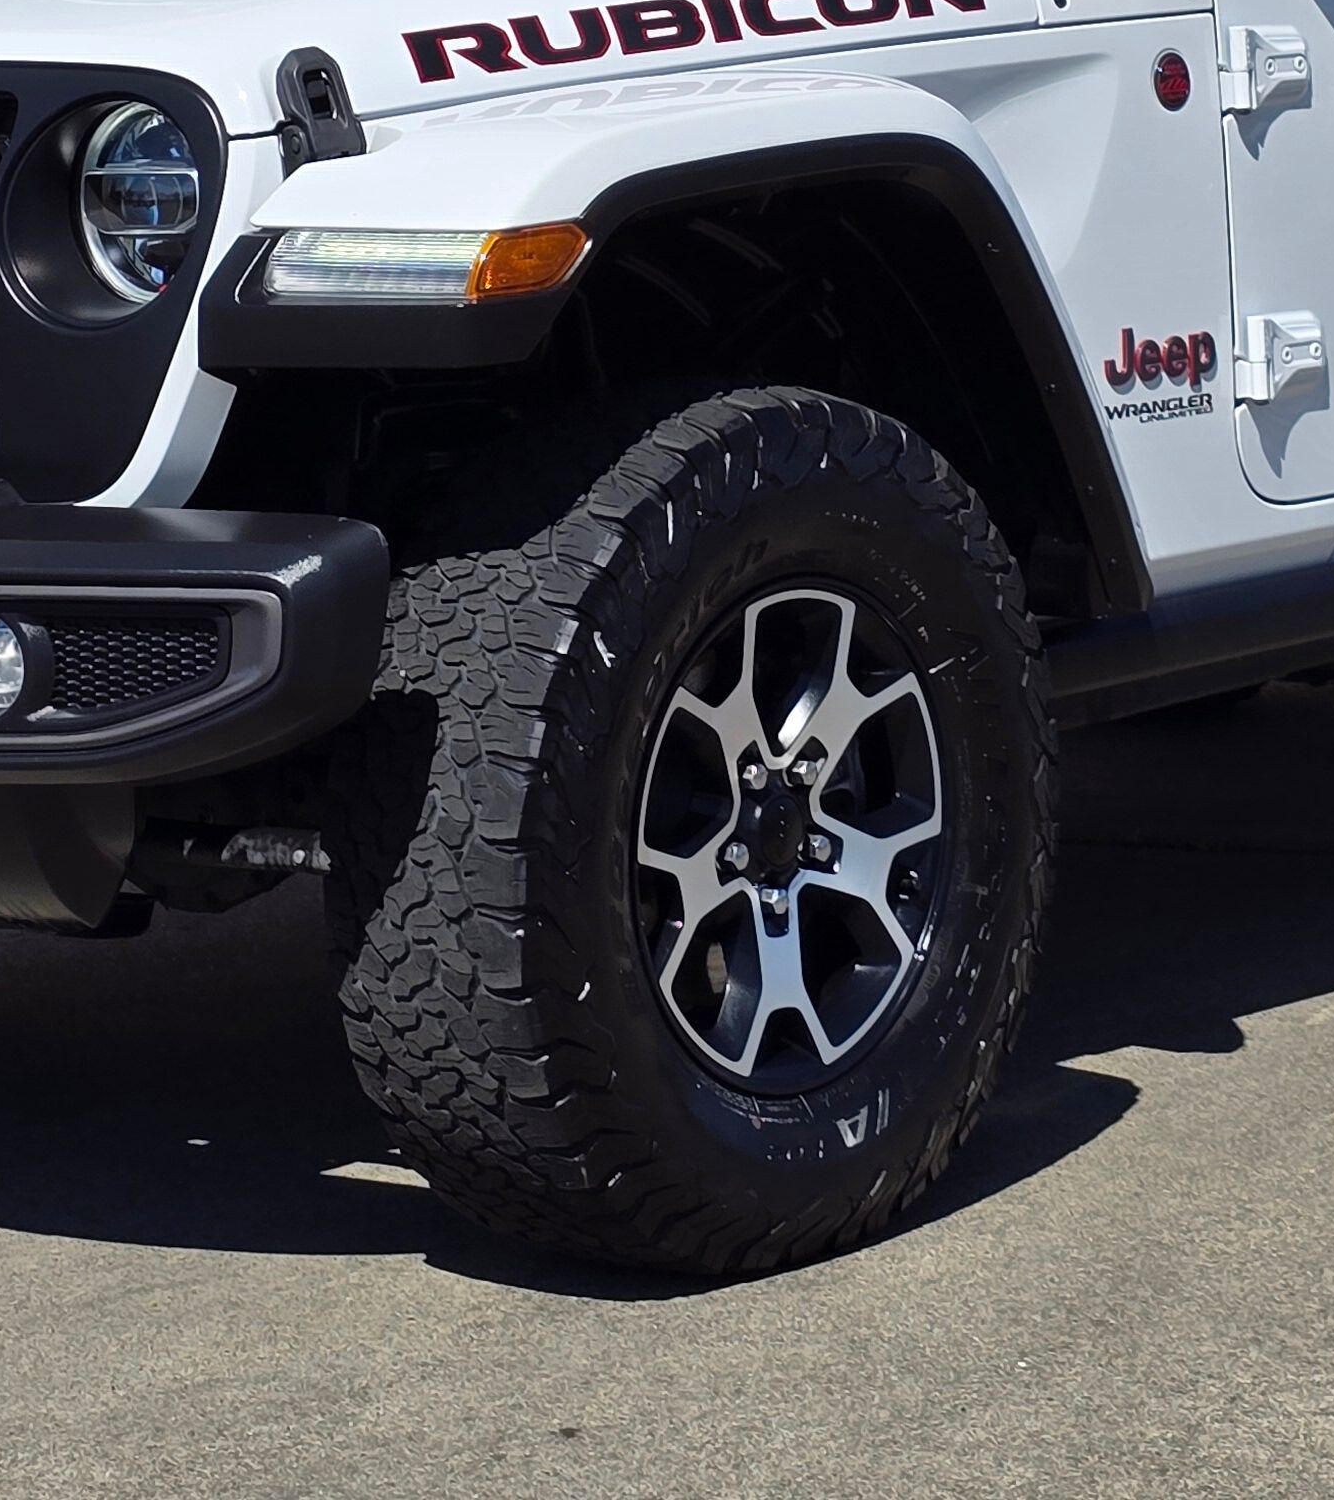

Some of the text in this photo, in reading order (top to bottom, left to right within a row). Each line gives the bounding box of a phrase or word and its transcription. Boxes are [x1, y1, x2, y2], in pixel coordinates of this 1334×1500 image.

[1104, 328, 1216, 388] Jeep
[1104, 393, 1212, 420] WRANGLER
[1139, 406, 1213, 423] UNLIMITED
